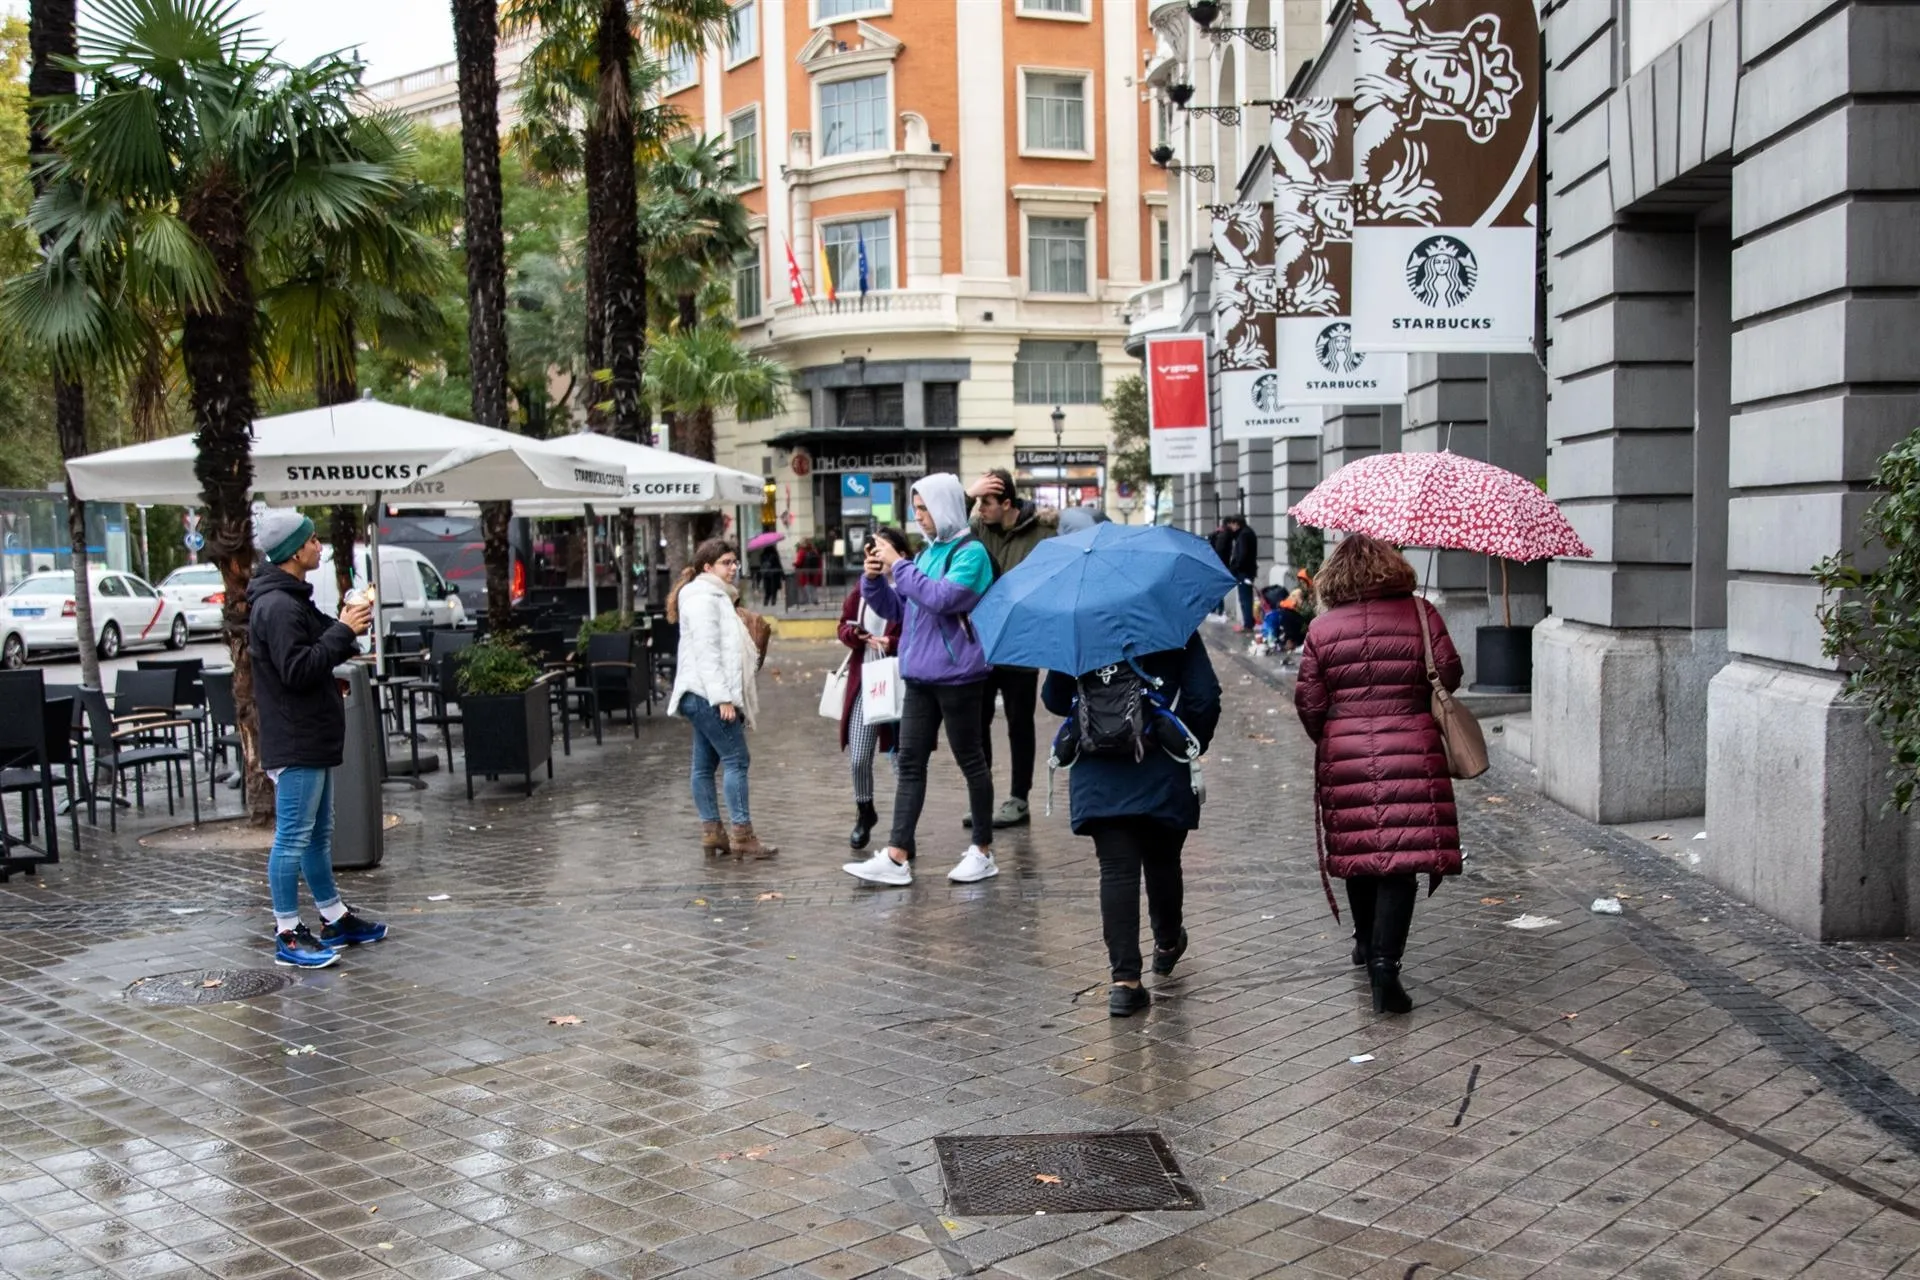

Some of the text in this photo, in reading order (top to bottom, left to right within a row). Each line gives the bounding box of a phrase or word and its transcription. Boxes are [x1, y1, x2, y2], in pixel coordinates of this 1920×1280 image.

[1392, 317, 1492, 329] STARBUCKS
[1306, 380, 1377, 389] STARBUCKS
[1245, 416, 1300, 426] STARBUCKS
[837, 453, 924, 470] COLLECTION
[287, 464, 411, 481] STARBUCKS
[574, 468, 604, 486] STARBUCKS
[645, 482, 701, 495] COFFEE
